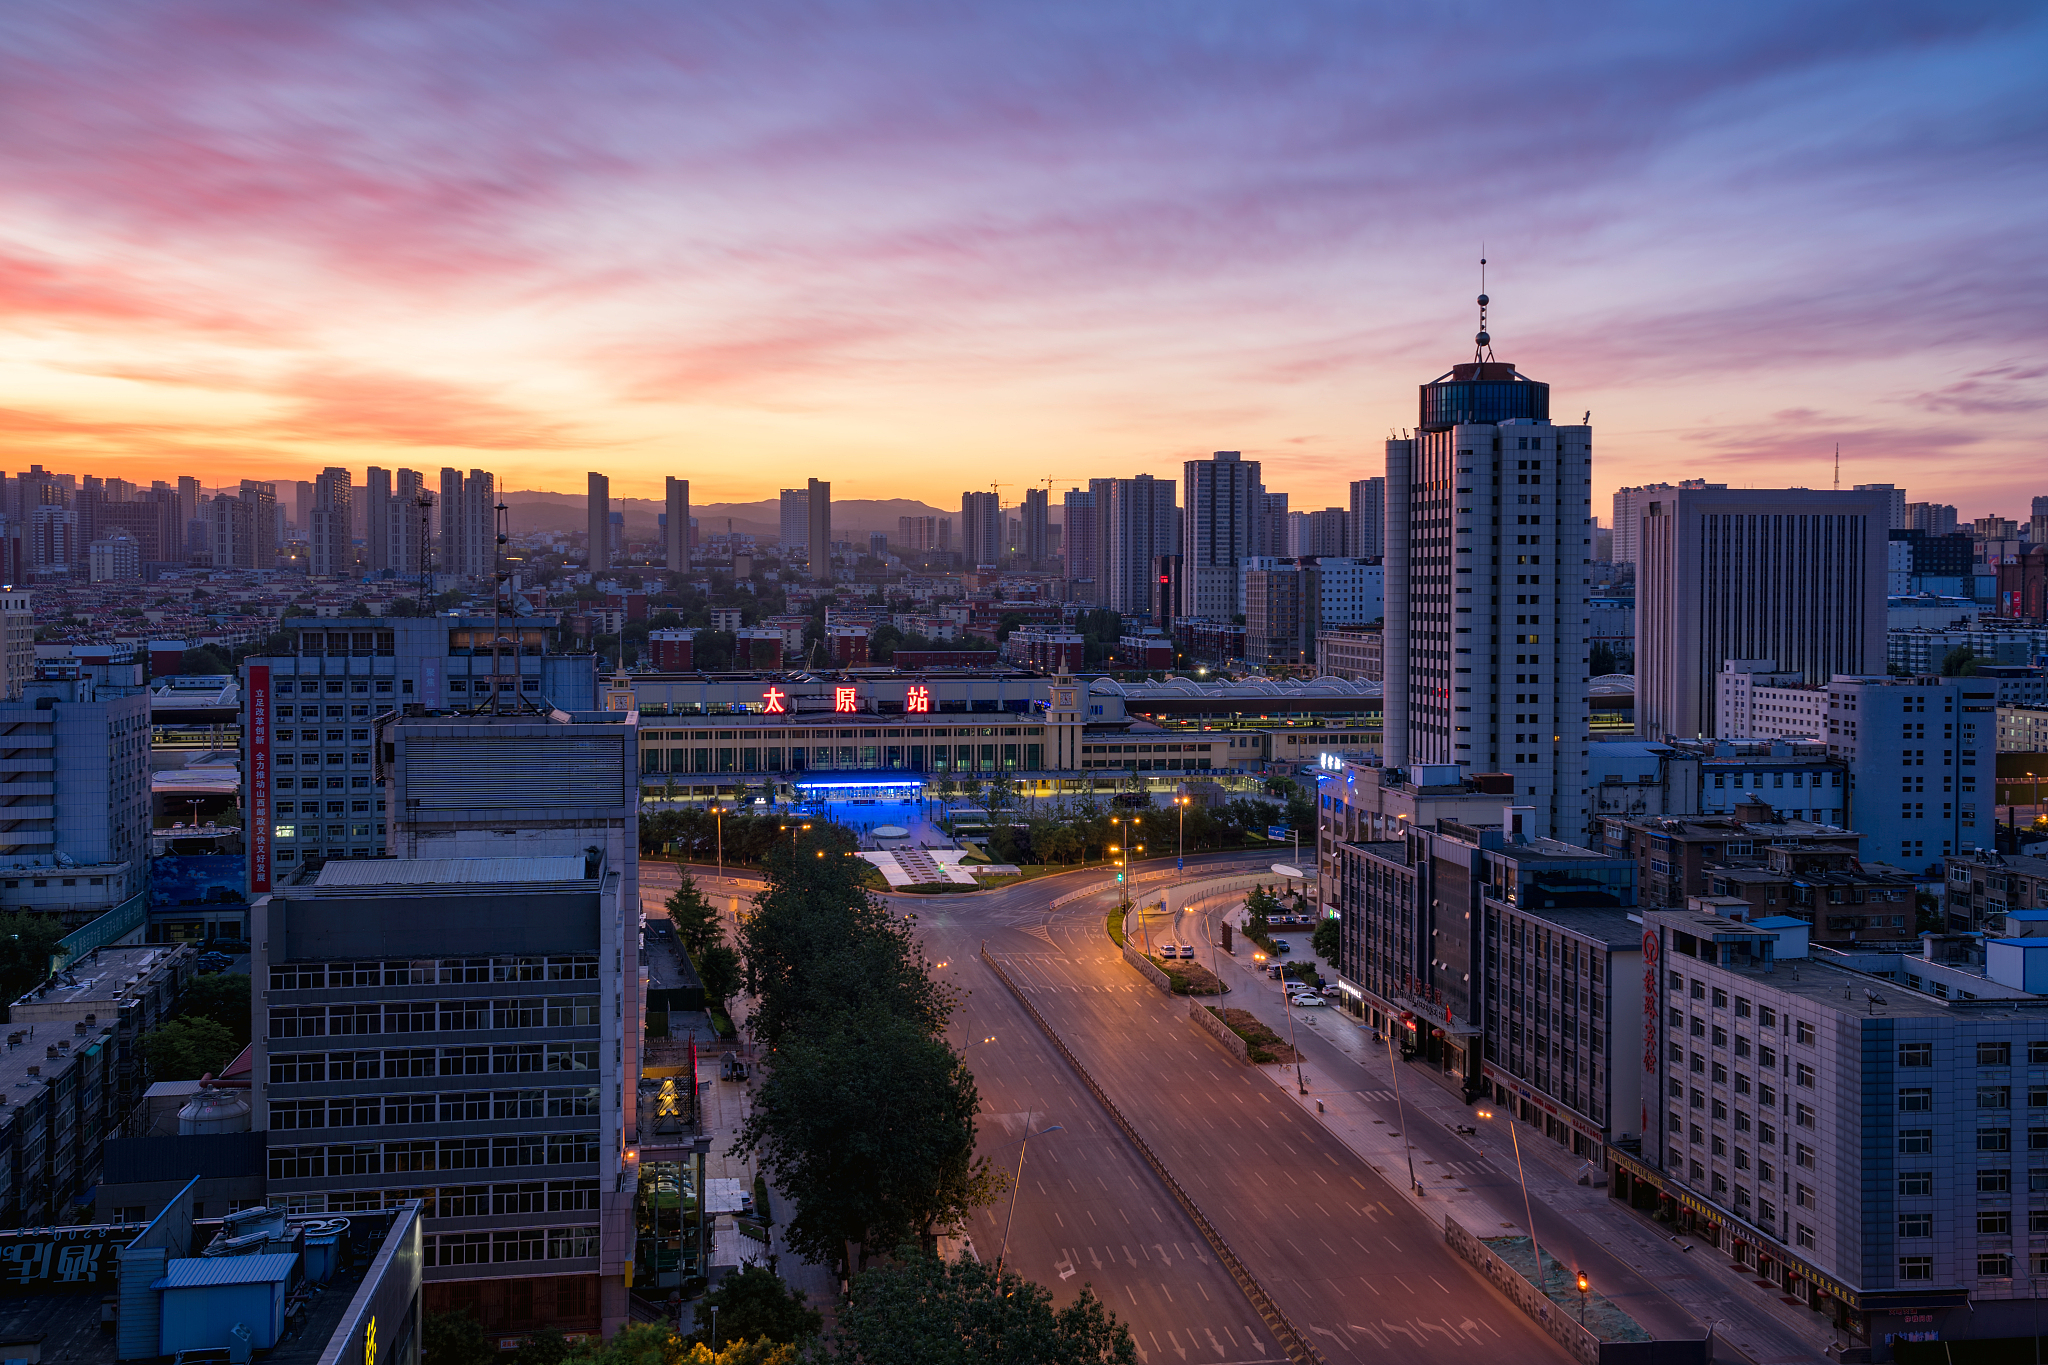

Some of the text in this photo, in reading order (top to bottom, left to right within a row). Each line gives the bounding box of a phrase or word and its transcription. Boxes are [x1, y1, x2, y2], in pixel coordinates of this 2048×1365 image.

[426, 667, 436, 707] 聚焦一体
[763, 685, 930, 713] 太原站
[255, 689, 266, 882] 立足改革创新 全力推动山西邮政又快又好发展
[1643, 968, 1658, 1074] 铁路宾馆
[1647, 1172, 1664, 1190] HOTEL
